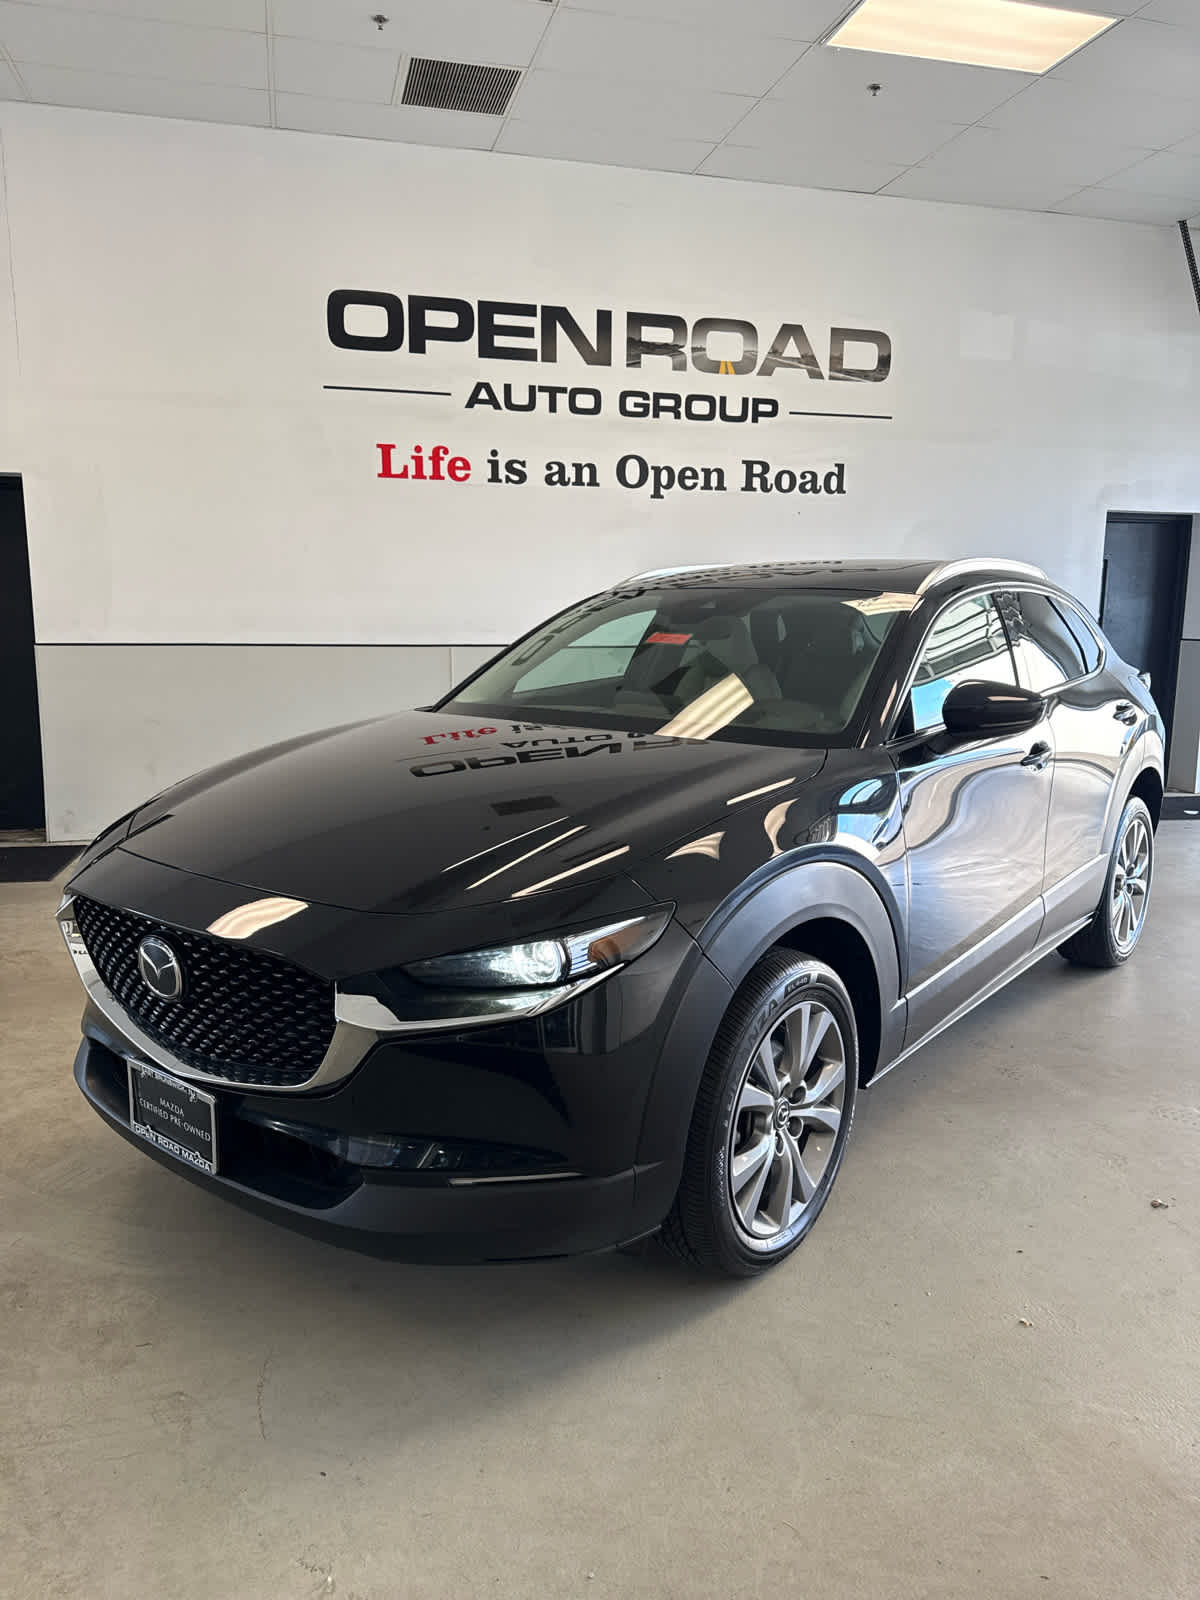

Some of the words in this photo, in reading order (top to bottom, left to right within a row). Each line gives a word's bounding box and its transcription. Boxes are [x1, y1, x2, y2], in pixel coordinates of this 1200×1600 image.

[327, 288, 612, 367] OPEN
[626, 311, 892, 383] ROAD
[465, 381, 602, 416] AUTO
[618, 390, 779, 424] GROUP
[376, 443, 472, 482] Life
[487, 449, 528, 485] is
[544, 461, 600, 488] an
[615, 454, 727, 500] Open
[740, 459, 847, 495] Road
[160, 1097, 185, 1117] MAZDA
[135, 1124, 156, 1142] OPEN
[157, 1136, 180, 1155] ROAD
[181, 1150, 210, 1172] MAZDA
